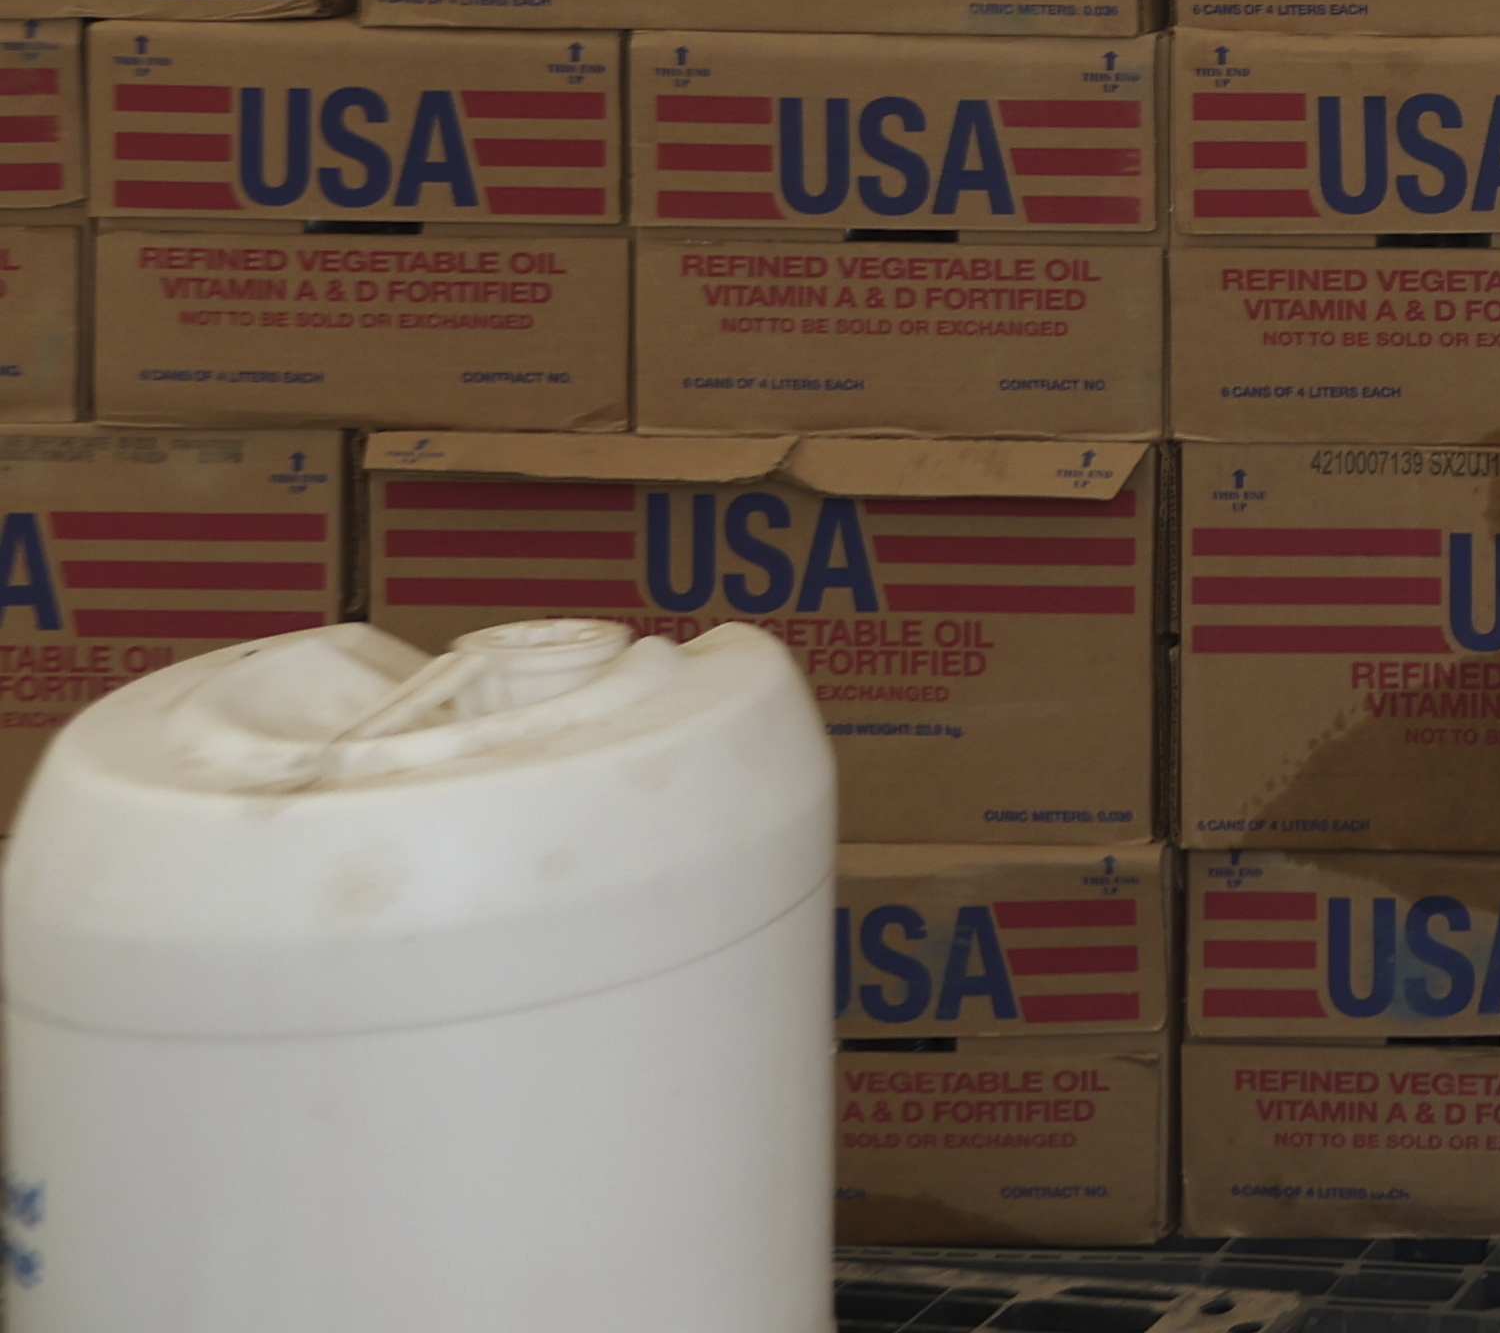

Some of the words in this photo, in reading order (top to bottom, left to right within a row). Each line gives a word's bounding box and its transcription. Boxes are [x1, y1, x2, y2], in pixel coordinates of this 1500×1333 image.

[779, 97, 1015, 216] USA
[681, 255, 829, 279] REFINED
[838, 256, 1035, 282] VEGETABLE
[1045, 259, 1100, 282] OIL
